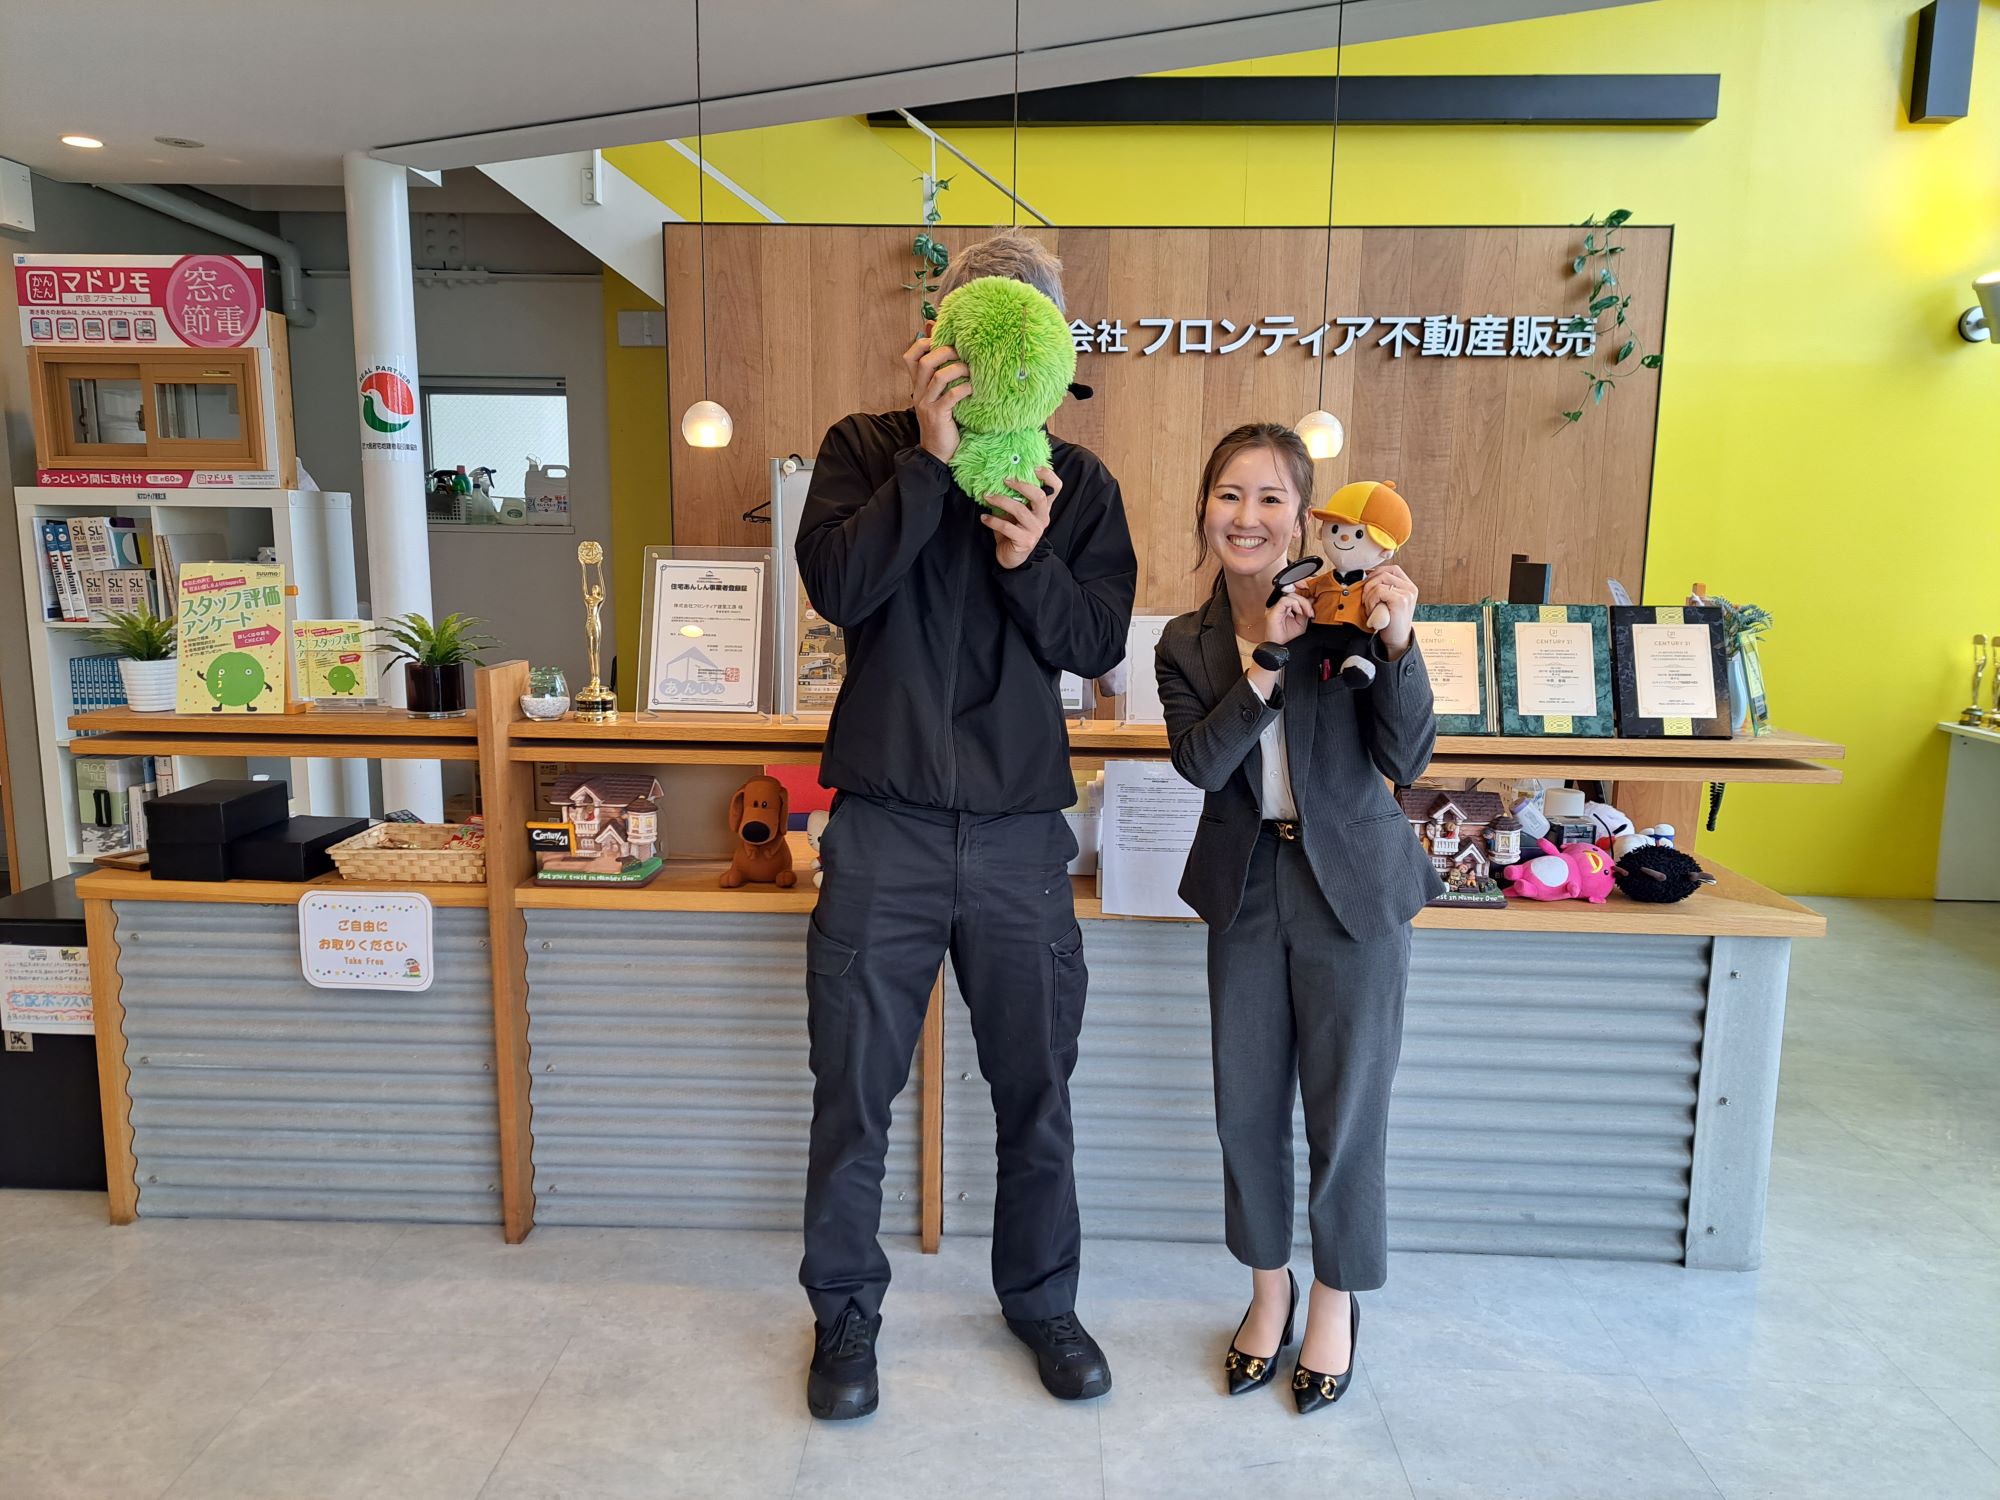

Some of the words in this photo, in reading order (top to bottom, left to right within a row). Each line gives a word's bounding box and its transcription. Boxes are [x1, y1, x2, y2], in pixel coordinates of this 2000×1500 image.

[32, 275, 53, 288] かん
[61, 269, 151, 293] マドリモ
[184, 266, 236, 302] 窓で
[32, 287, 54, 299] たん
[182, 304, 245, 337] 節電
[1138, 314, 1598, 359] フロンティア不動産販売
[360, 367, 373, 384] REAL
[376, 365, 411, 385] PARTNER
[41, 473, 142, 485] あっという間に取付け
[181, 585, 281, 618] スタッフ評価
[183, 612, 252, 637] アンケート
[664, 682, 723, 694] あんしん
[532, 830, 561, 841] Century
[558, 836, 568, 845] 21
[1458, 894, 1484, 902] Number
[338, 920, 388, 932] ご自由に
[318, 939, 408, 952] お取りください
[344, 956, 362, 965] Take
[366, 957, 384, 966] Free
